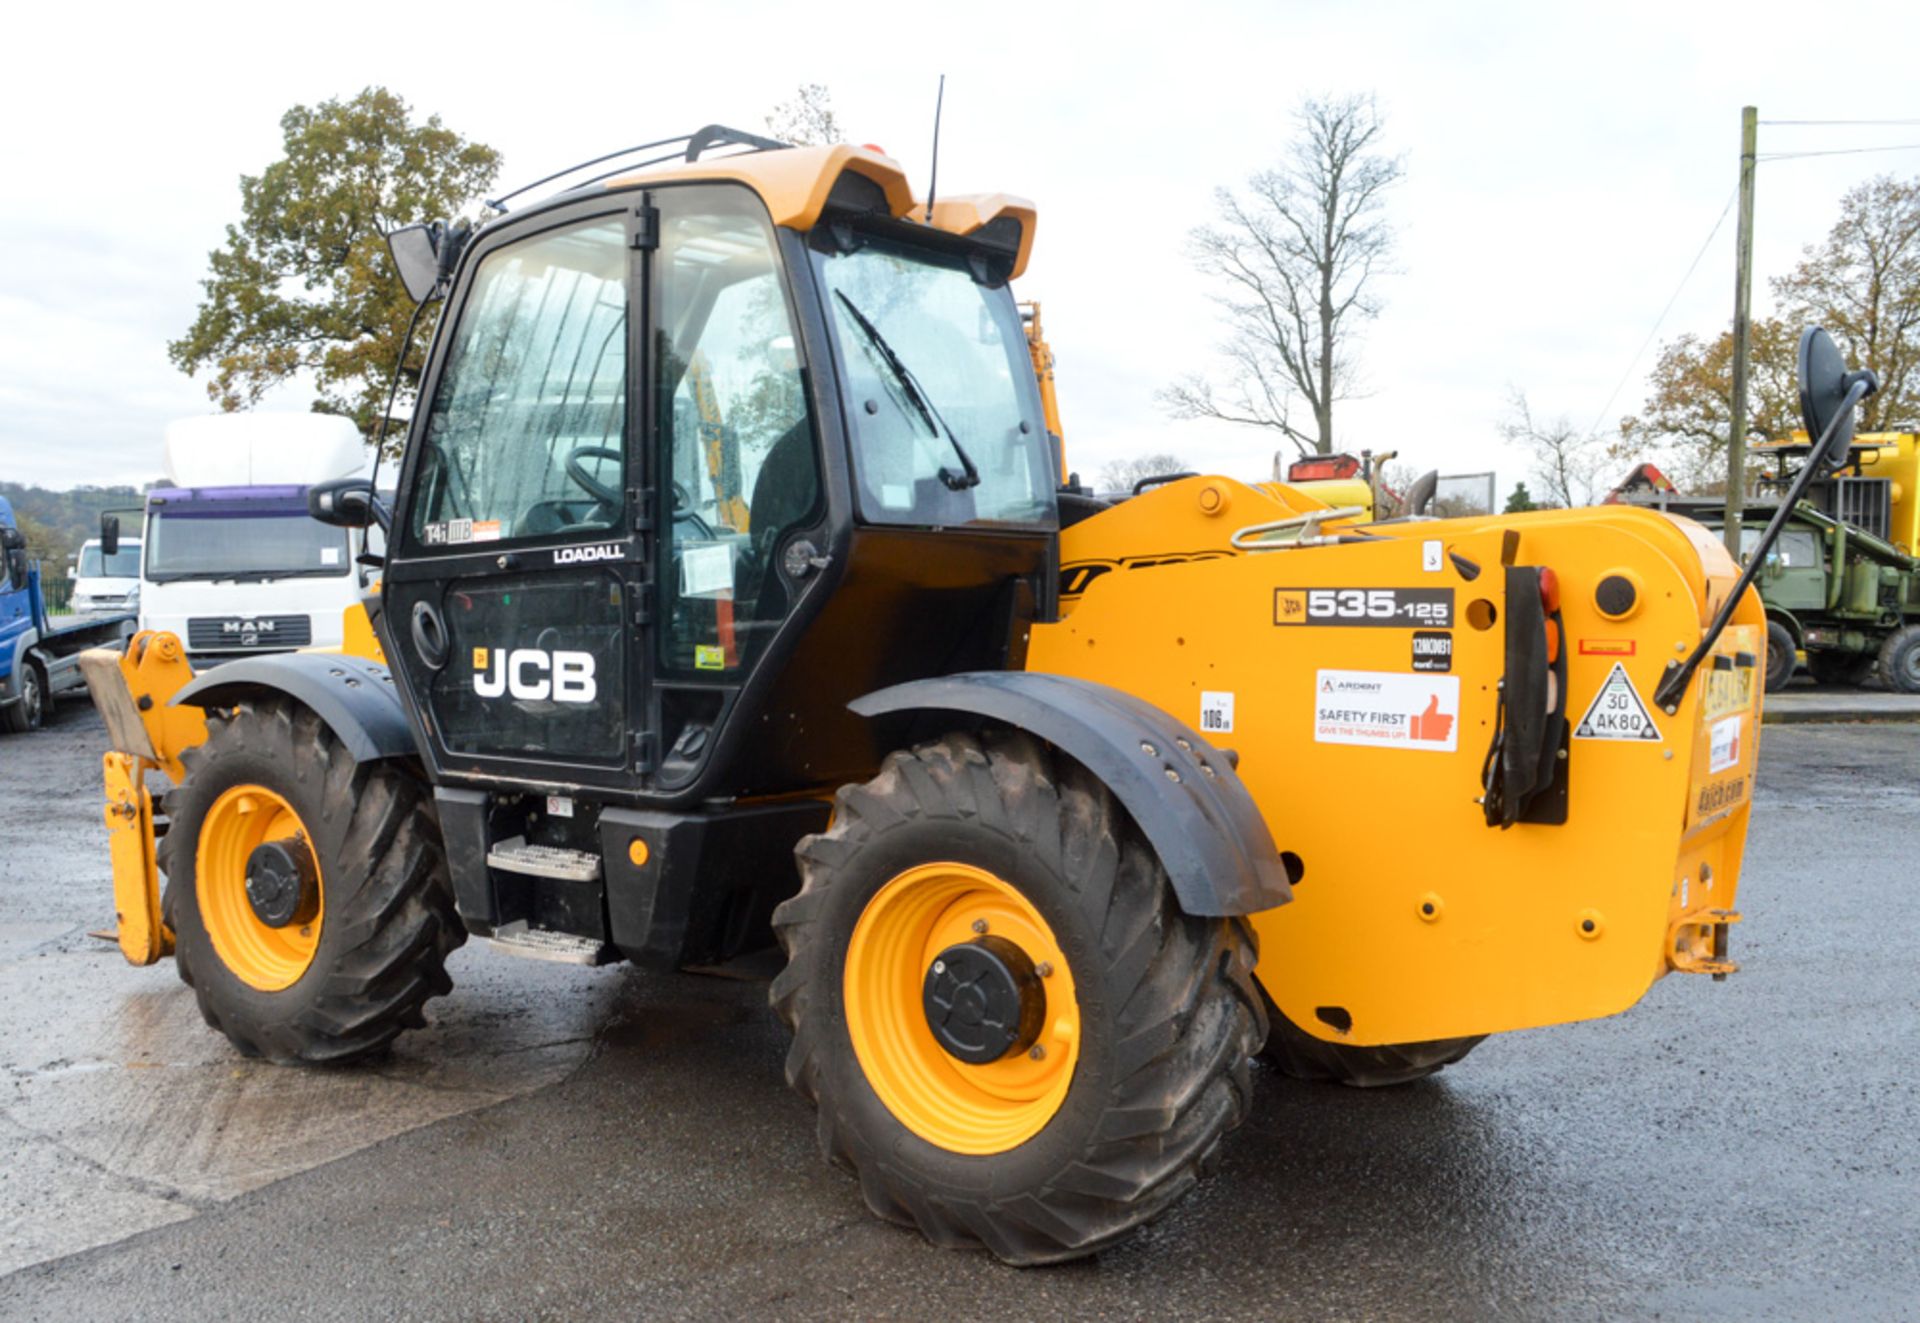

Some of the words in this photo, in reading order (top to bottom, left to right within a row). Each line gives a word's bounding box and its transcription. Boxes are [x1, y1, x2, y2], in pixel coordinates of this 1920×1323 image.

[553, 544, 625, 565] LOADALL
[1308, 590, 1448, 618] 535-125
[223, 620, 275, 633] MAN
[473, 648, 597, 703] JCB
[1338, 681, 1383, 691] ARDENT
[1318, 708, 1367, 722] SAFETY
[1370, 712, 1406, 725] FIRST
[1596, 713, 1642, 731] AK8Q
[1318, 726, 1337, 735] GIVE
[1339, 727, 1355, 736] THE
[1356, 729, 1391, 738] THUMBS
